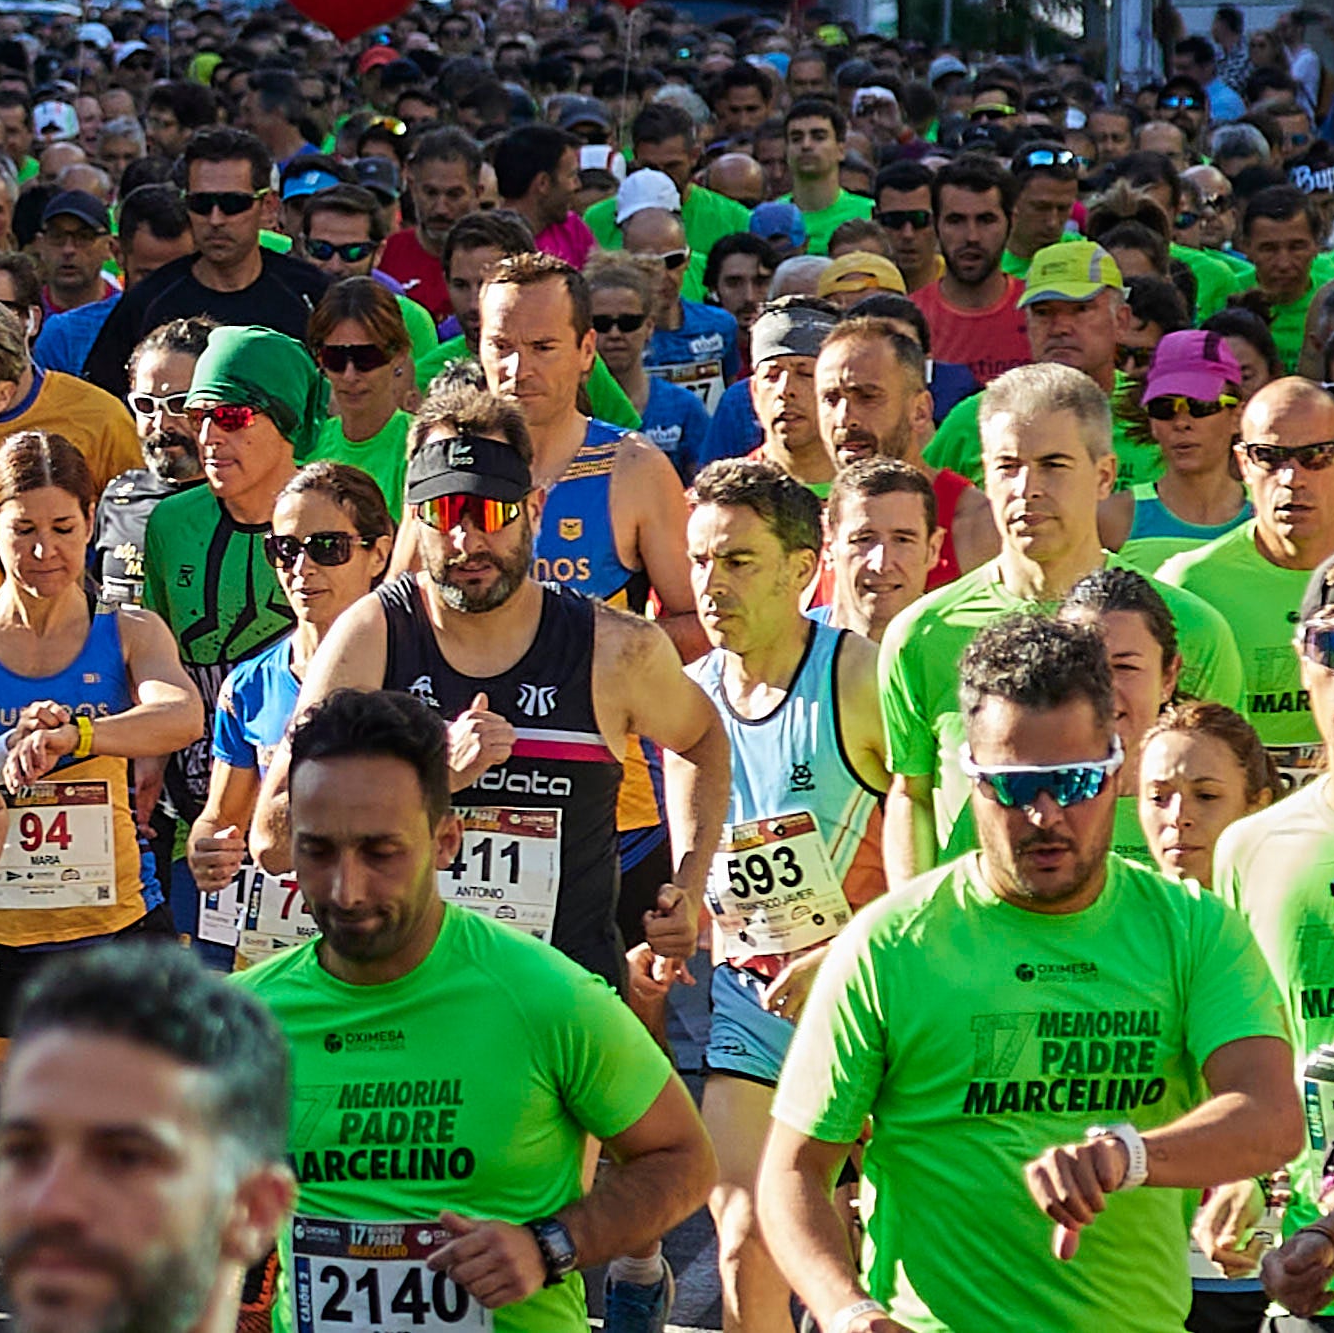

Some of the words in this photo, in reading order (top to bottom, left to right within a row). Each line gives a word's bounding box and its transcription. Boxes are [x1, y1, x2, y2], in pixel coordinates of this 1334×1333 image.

[533, 557, 591, 582] nos
[19, 810, 72, 853] 94
[30, 854, 61, 866] MARIA
[727, 845, 803, 899] 593
[455, 886, 504, 899] ANTONIO
[345, 1029, 406, 1044] OXIMESA
[1036, 1009, 1162, 1039] MEMORIAL
[1040, 1039, 1156, 1076] PADRE
[338, 1079, 464, 1110] MEMORIAL
[962, 1076, 1167, 1115] MARCELINO
[339, 1109, 457, 1145] PADRE
[348, 1244, 409, 1258] MARCELINO
[319, 1264, 469, 1325] 2140
